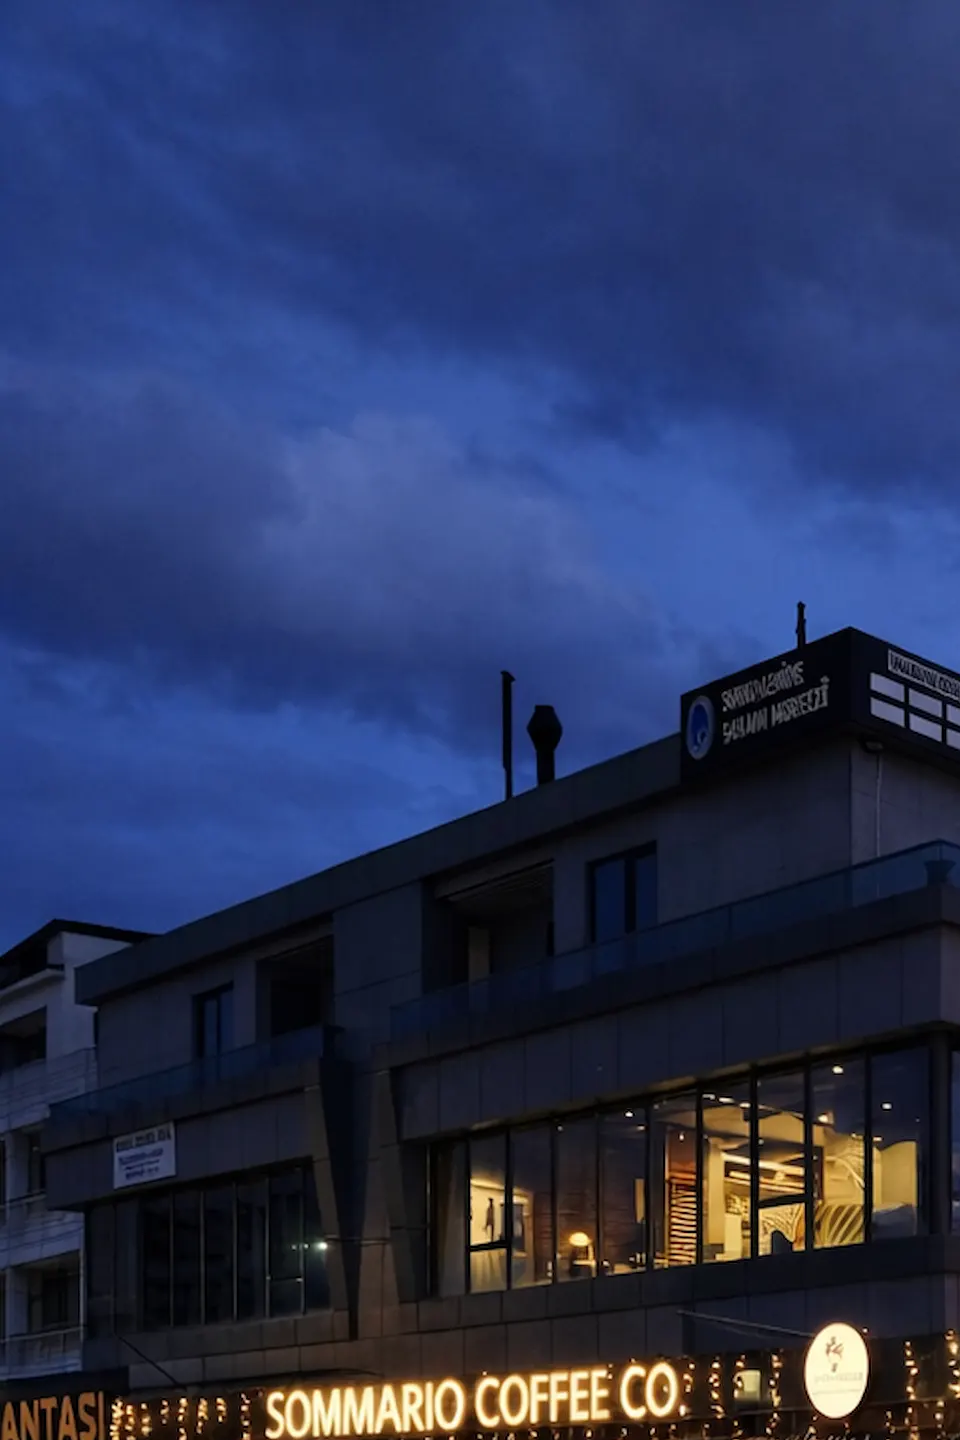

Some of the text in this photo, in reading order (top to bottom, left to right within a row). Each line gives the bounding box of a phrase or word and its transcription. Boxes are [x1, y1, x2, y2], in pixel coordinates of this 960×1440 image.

[265, 1362, 689, 1440] SOMMARIO COFFEE CO.
